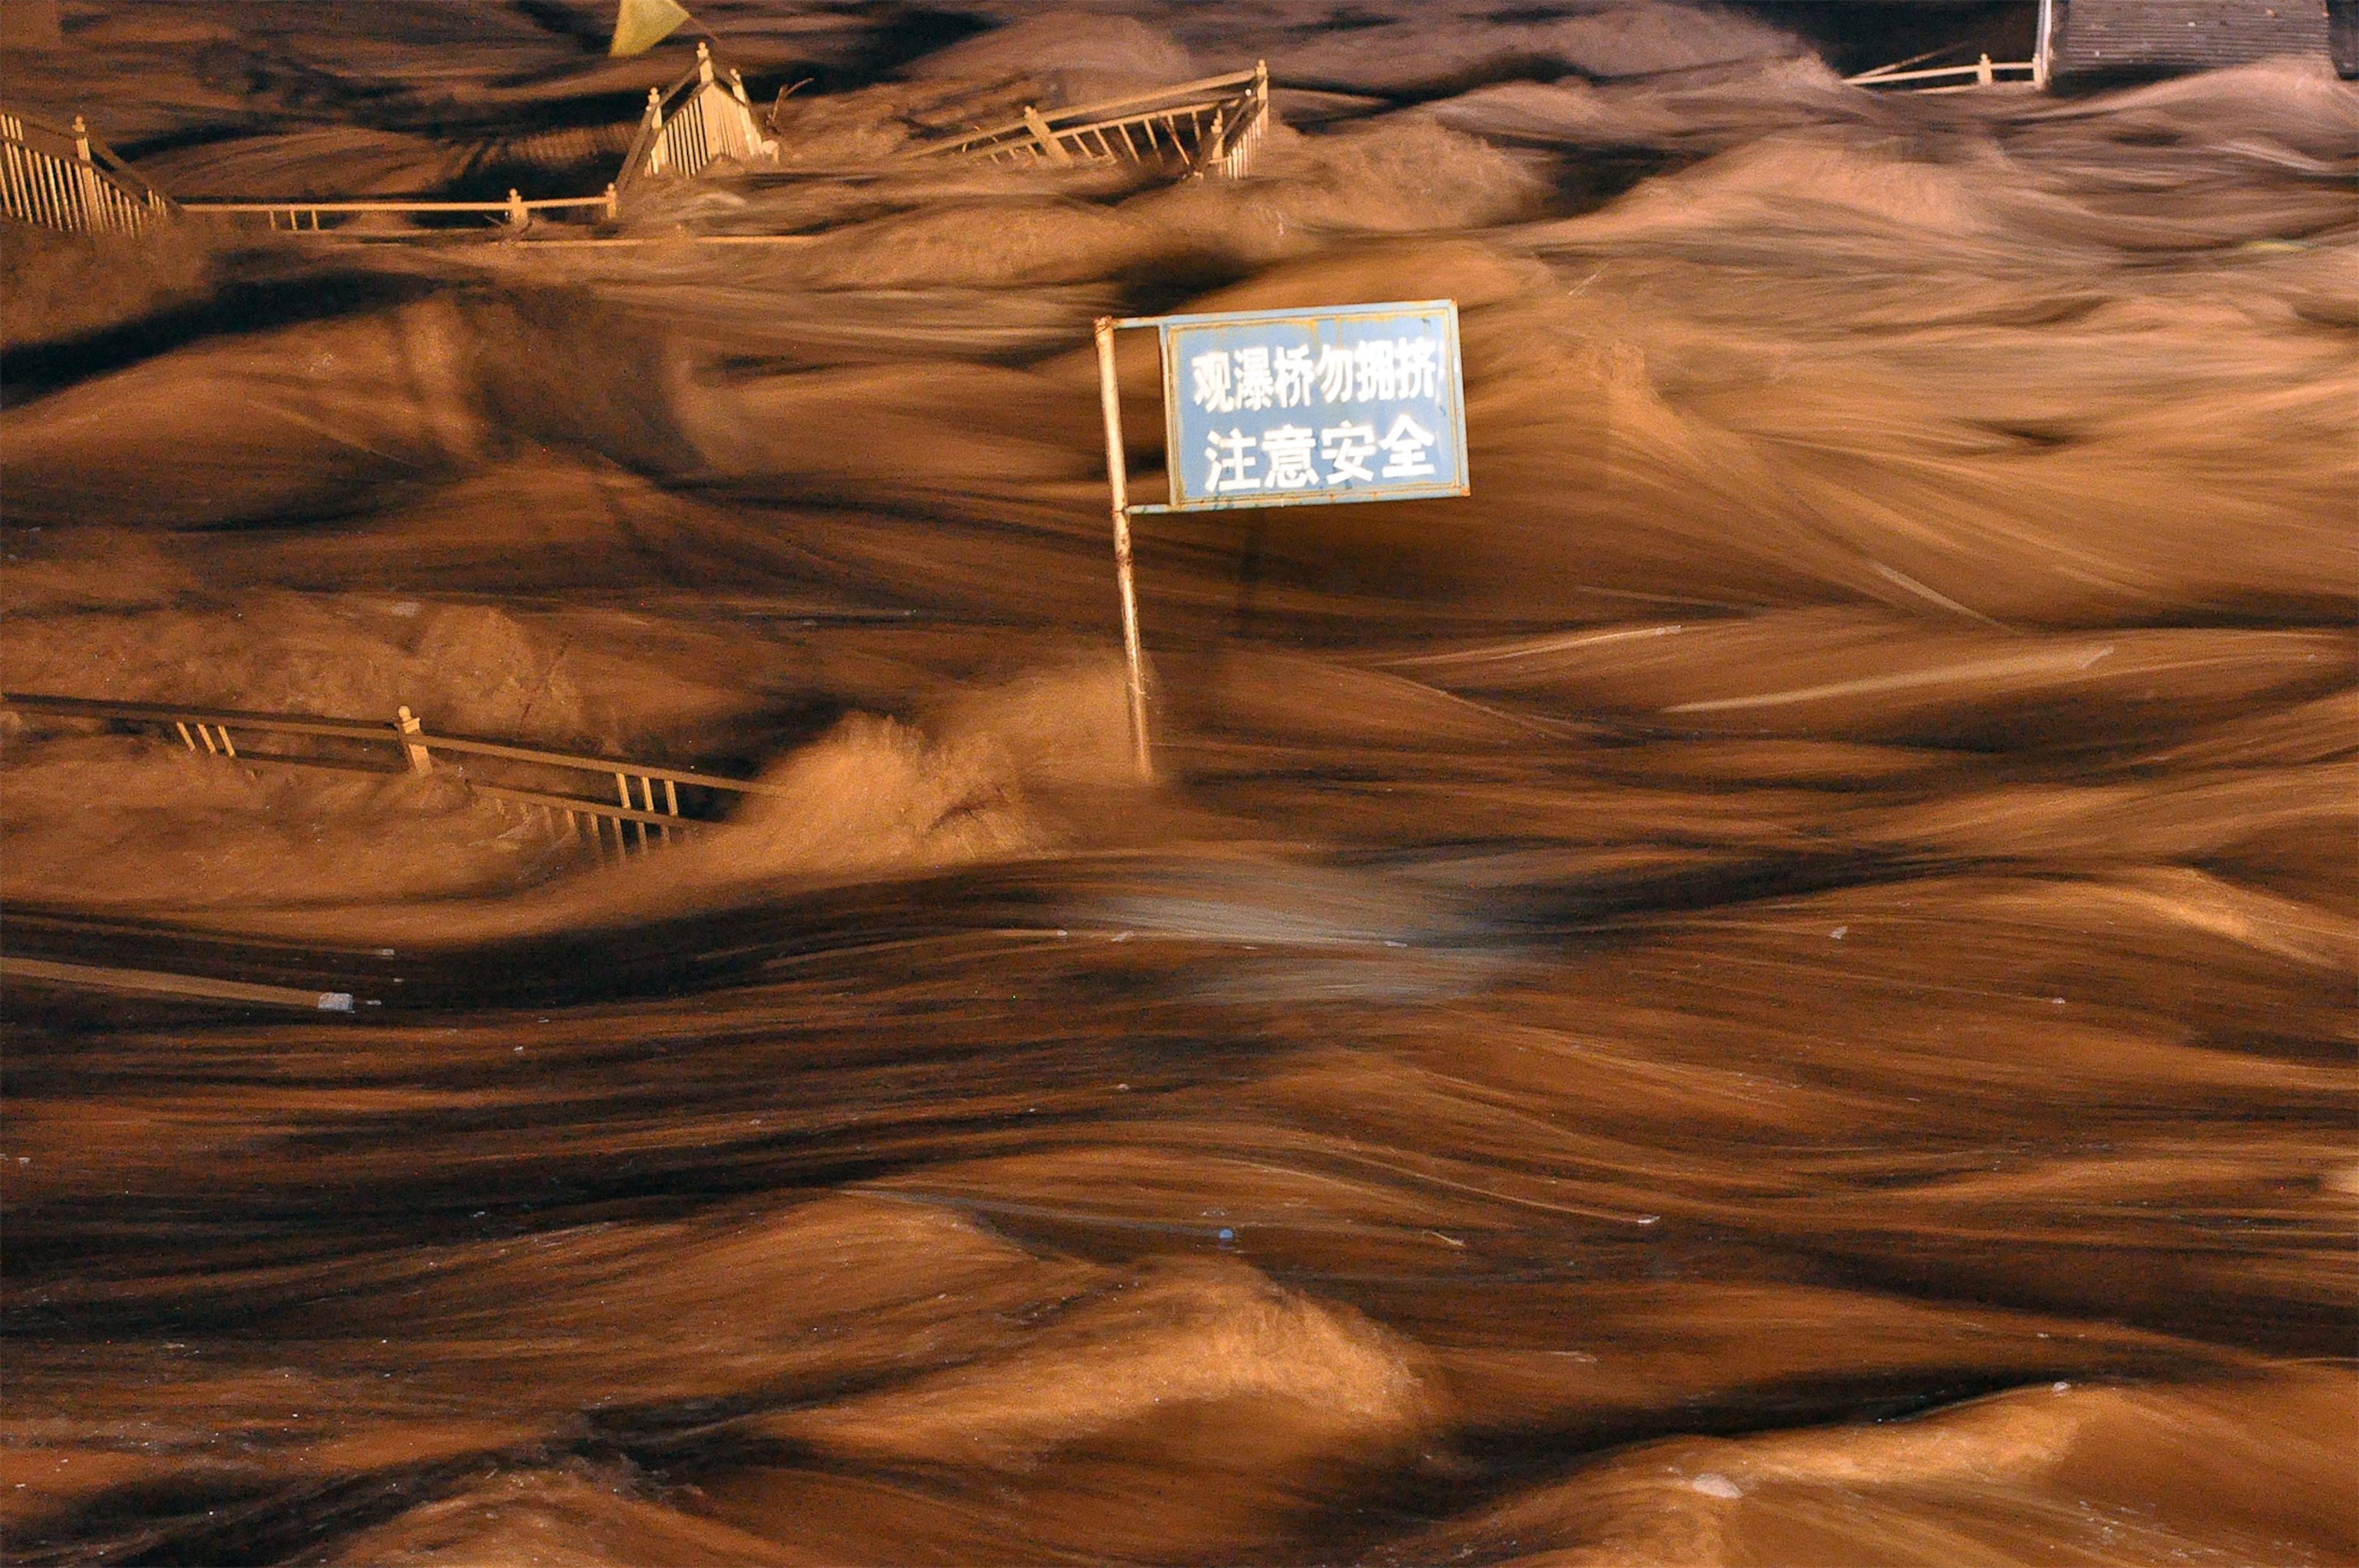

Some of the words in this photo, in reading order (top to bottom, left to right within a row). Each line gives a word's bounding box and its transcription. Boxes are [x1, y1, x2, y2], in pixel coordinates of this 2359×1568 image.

[1193, 336, 1436, 412] 观瀑桥勿拥挤
[1205, 415, 1435, 492] 注意安全
